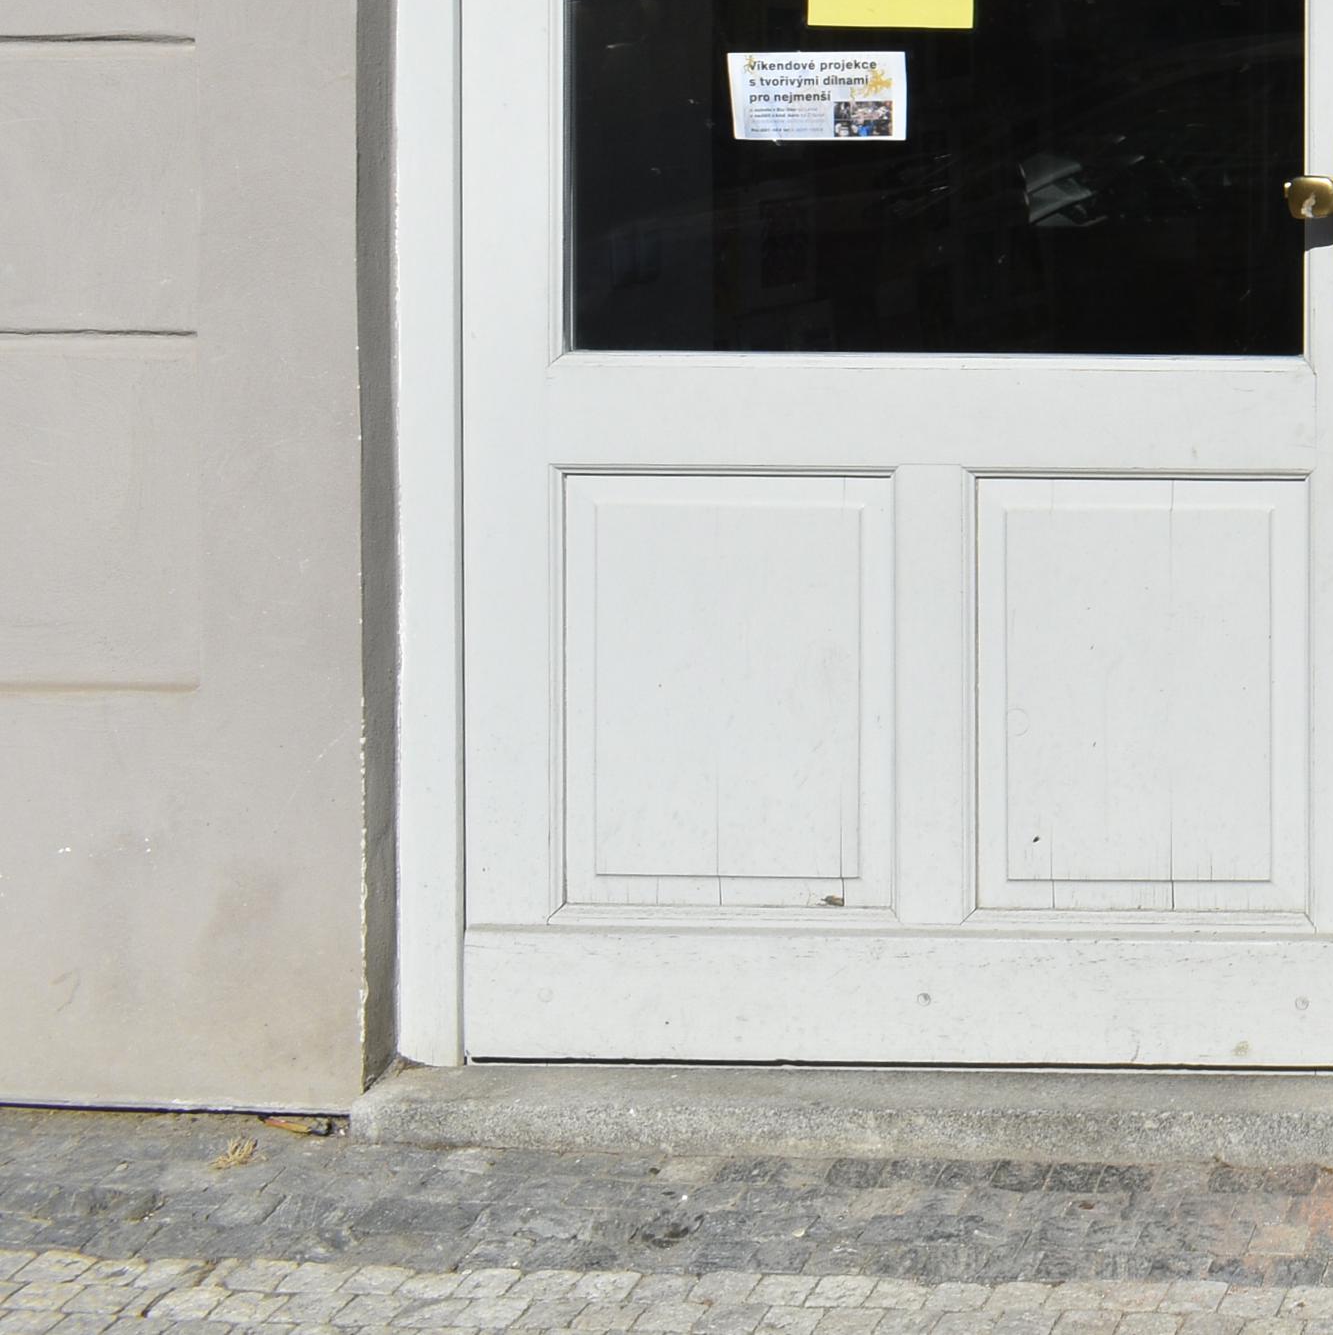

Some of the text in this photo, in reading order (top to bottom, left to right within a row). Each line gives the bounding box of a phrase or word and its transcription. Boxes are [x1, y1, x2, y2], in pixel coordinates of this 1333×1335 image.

[820, 59, 877, 72] projekce
[749, 74, 869, 88] s tvořivými dílnami
[749, 90, 831, 104] pro nejmenší
